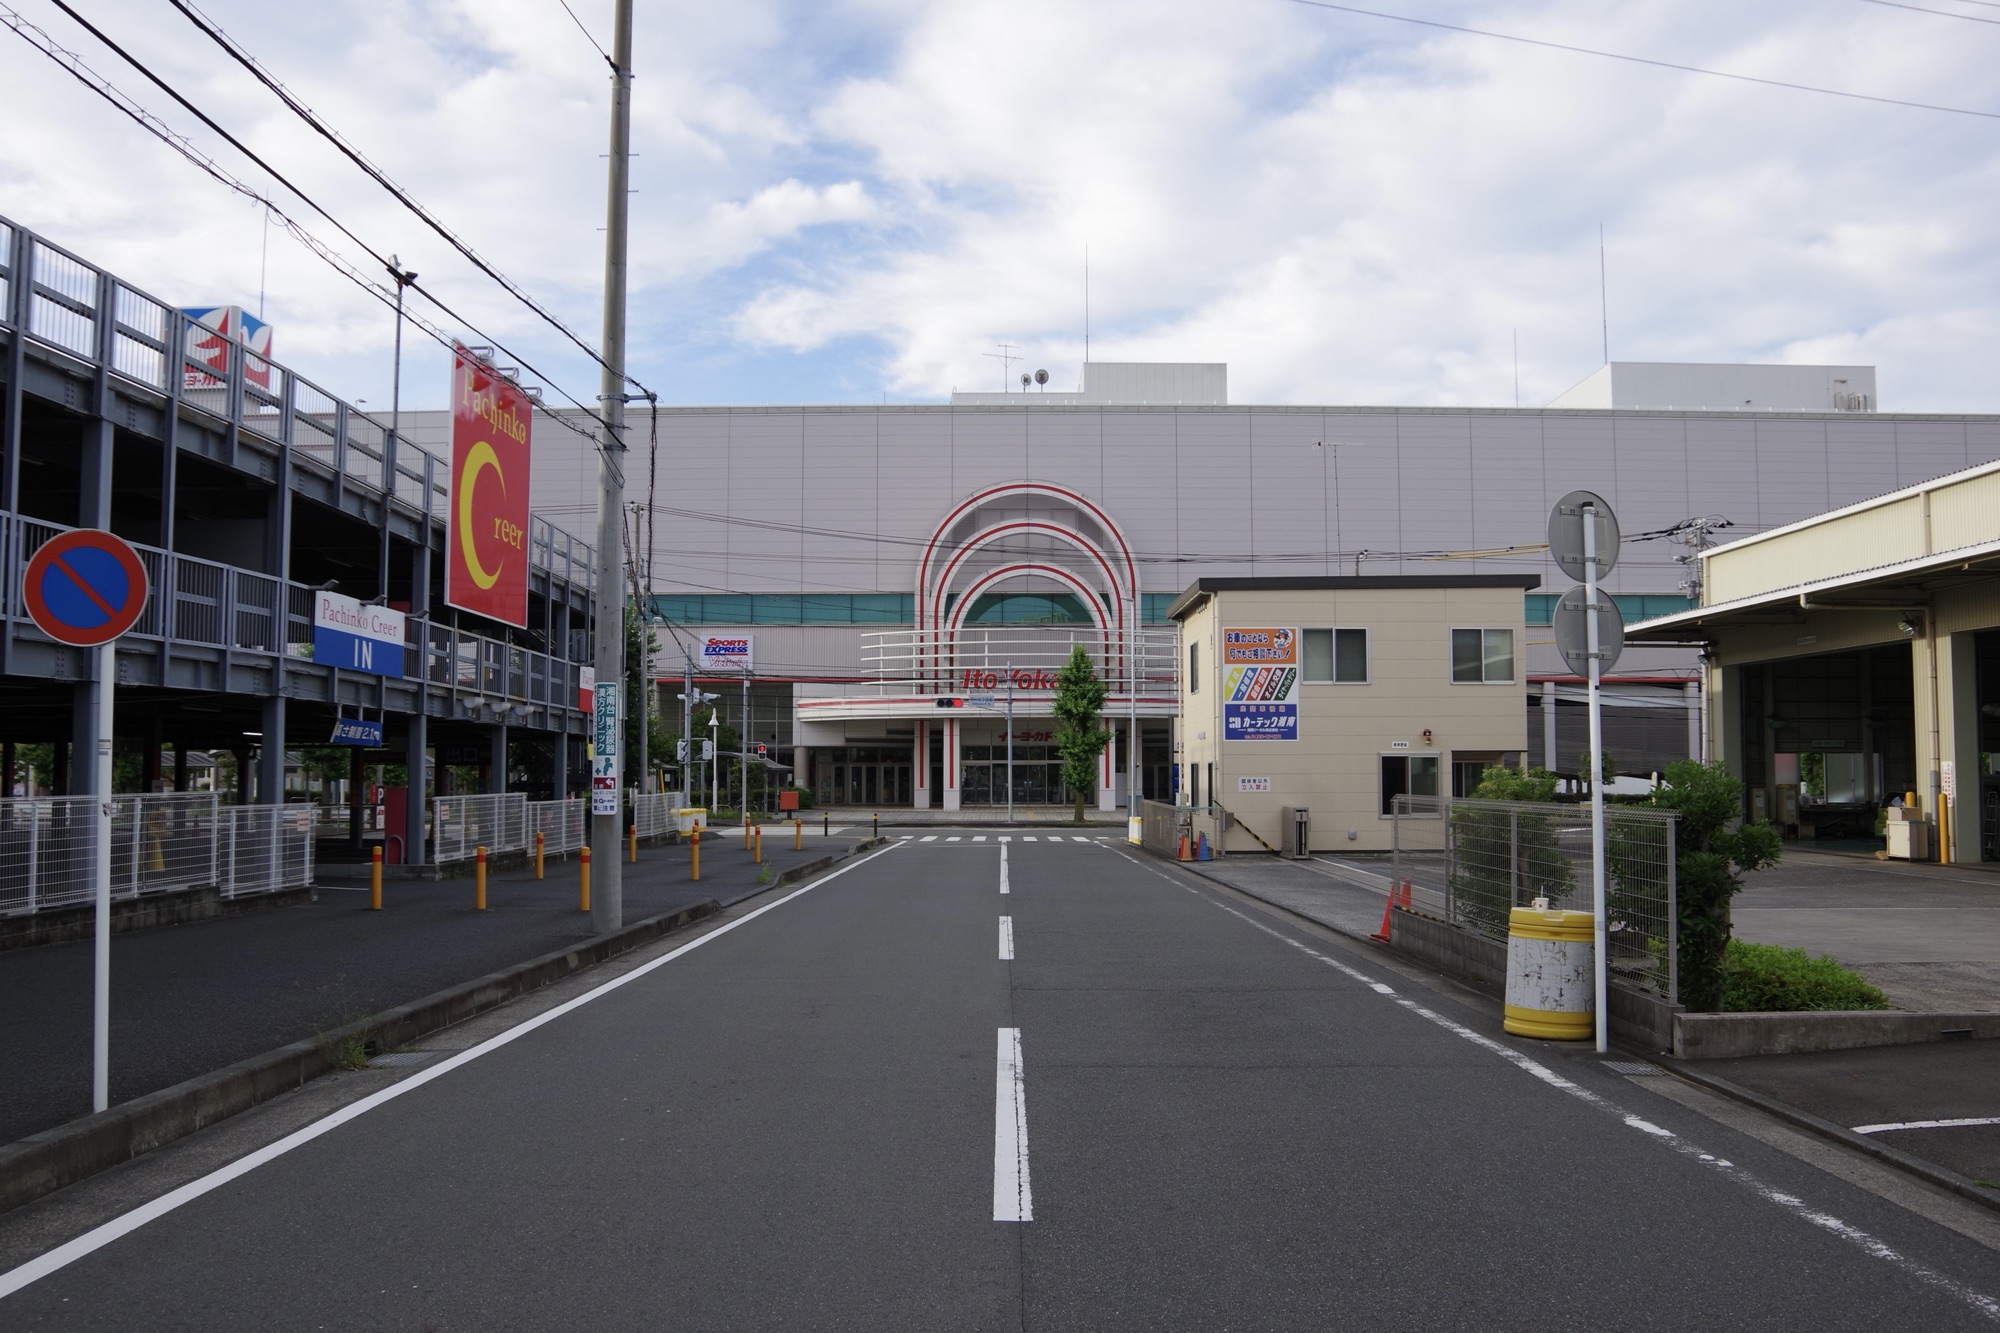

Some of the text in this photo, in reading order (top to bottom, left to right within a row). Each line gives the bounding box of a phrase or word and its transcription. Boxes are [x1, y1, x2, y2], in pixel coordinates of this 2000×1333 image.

[463, 367, 526, 444] Pachinko
[322, 599, 397, 637] Pachinko Creer
[707, 638, 748, 647] SPORTS
[1227, 631, 1269, 644] お車のことなら
[354, 638, 372, 669] IN
[704, 645, 748, 653] EXPRESS
[962, 669, 998, 689] Ito
[1243, 715, 1296, 727] カーテック湘南
[377, 787, 384, 804] P
